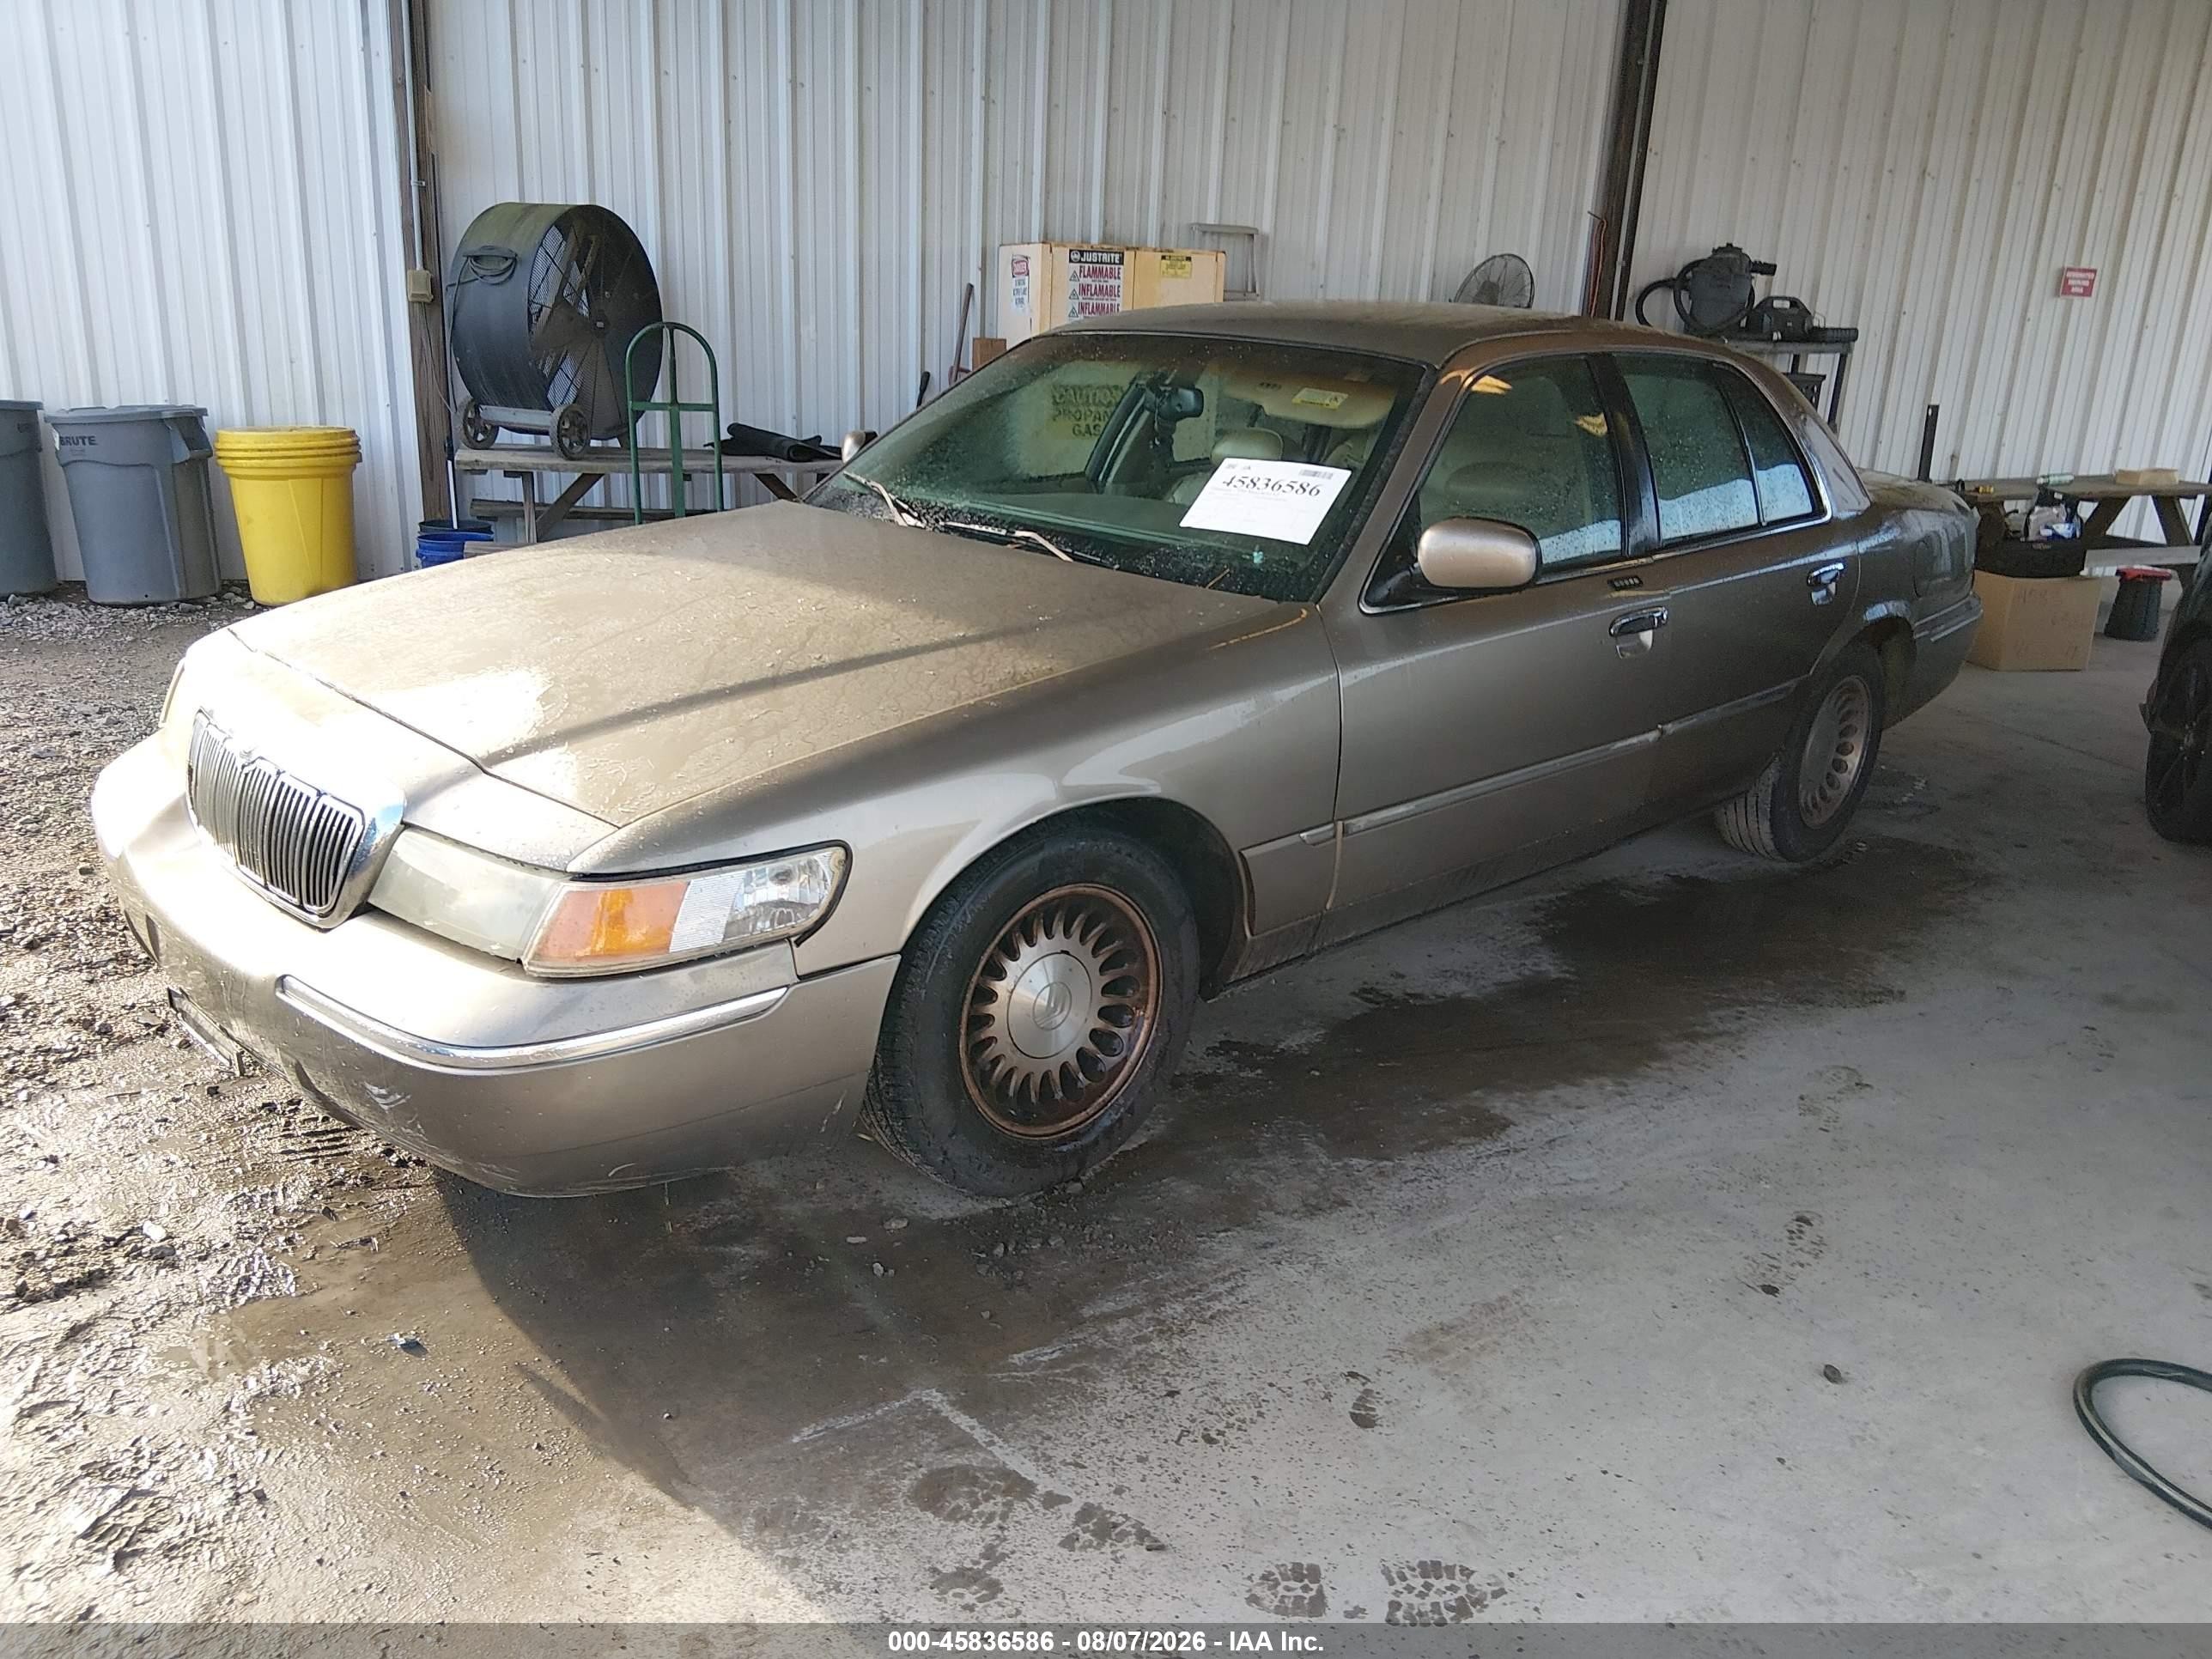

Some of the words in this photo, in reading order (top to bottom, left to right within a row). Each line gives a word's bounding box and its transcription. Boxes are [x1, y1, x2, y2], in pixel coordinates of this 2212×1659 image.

[1081, 251, 1120, 264] JUSTRITE
[1079, 265, 1121, 280] FLAMMABLE
[1079, 283, 1121, 298] INFLAMABLE
[59, 435, 98, 447] BRUTE
[1222, 474, 1324, 497] 45836586
